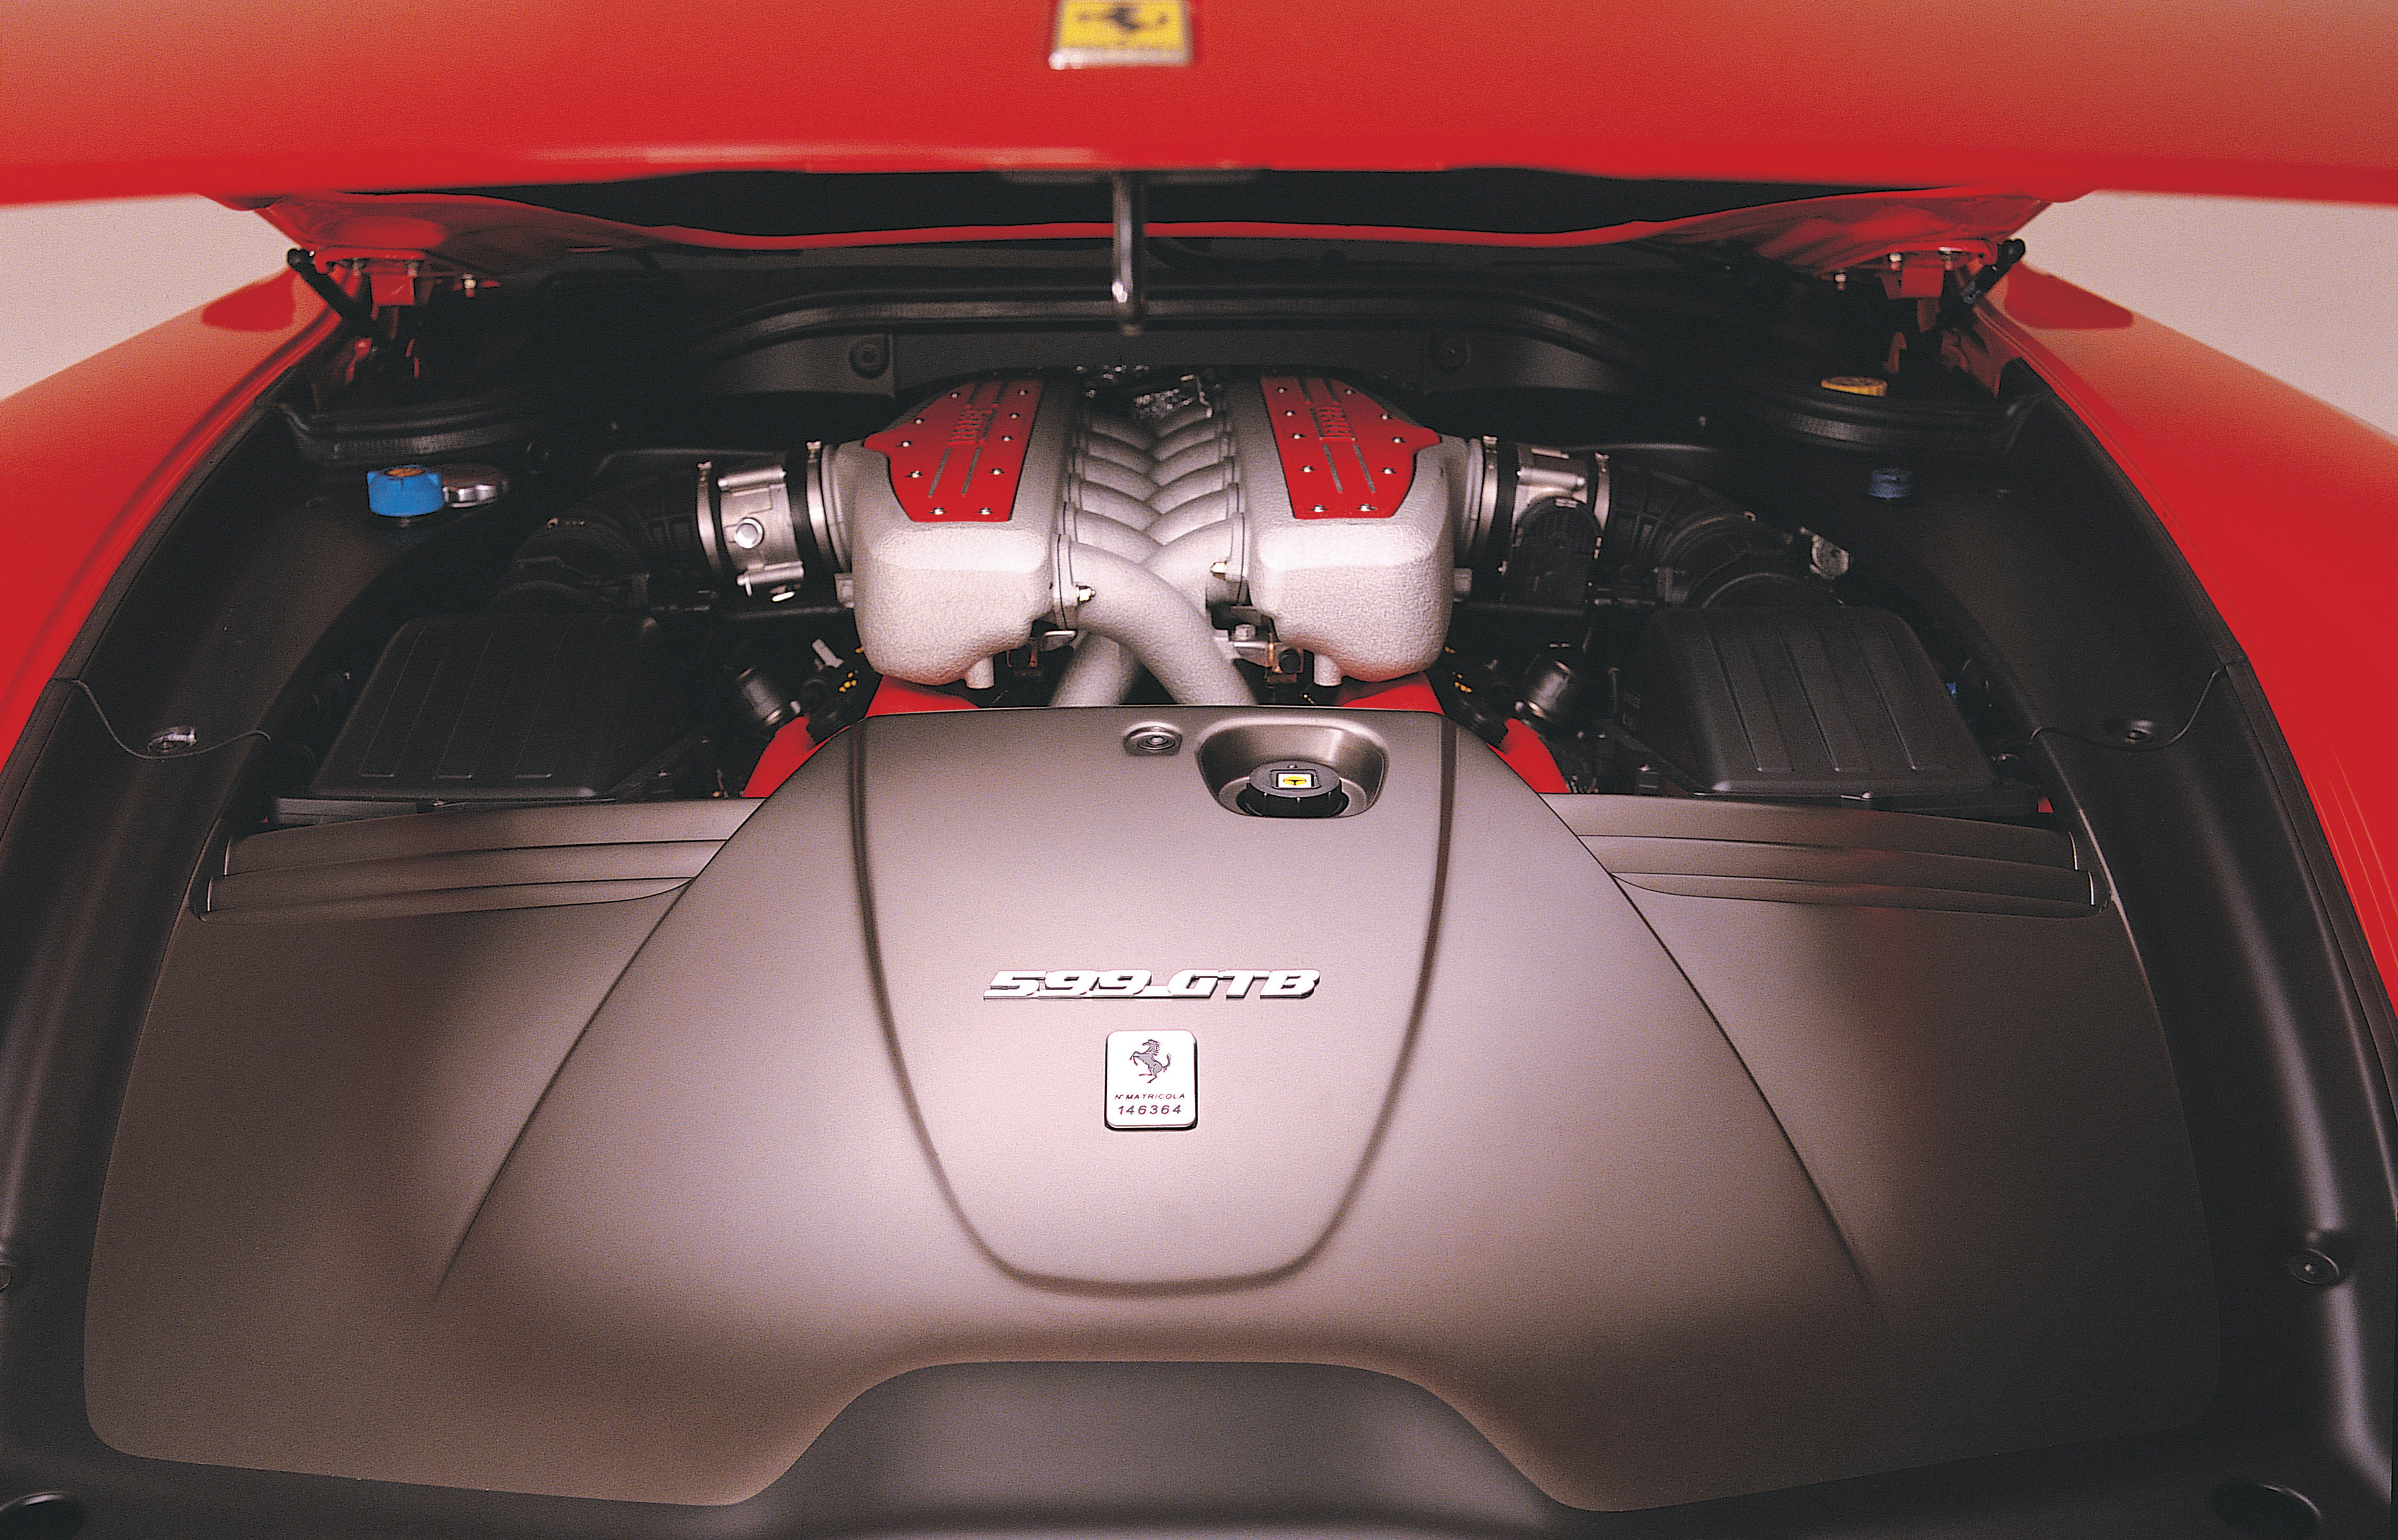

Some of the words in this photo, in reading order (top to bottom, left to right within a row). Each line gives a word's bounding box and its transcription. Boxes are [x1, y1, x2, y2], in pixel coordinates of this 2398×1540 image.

[983, 969, 1152, 999] 599
[1167, 969, 1320, 999] GTB
[1118, 1105, 1181, 1115] 146364
